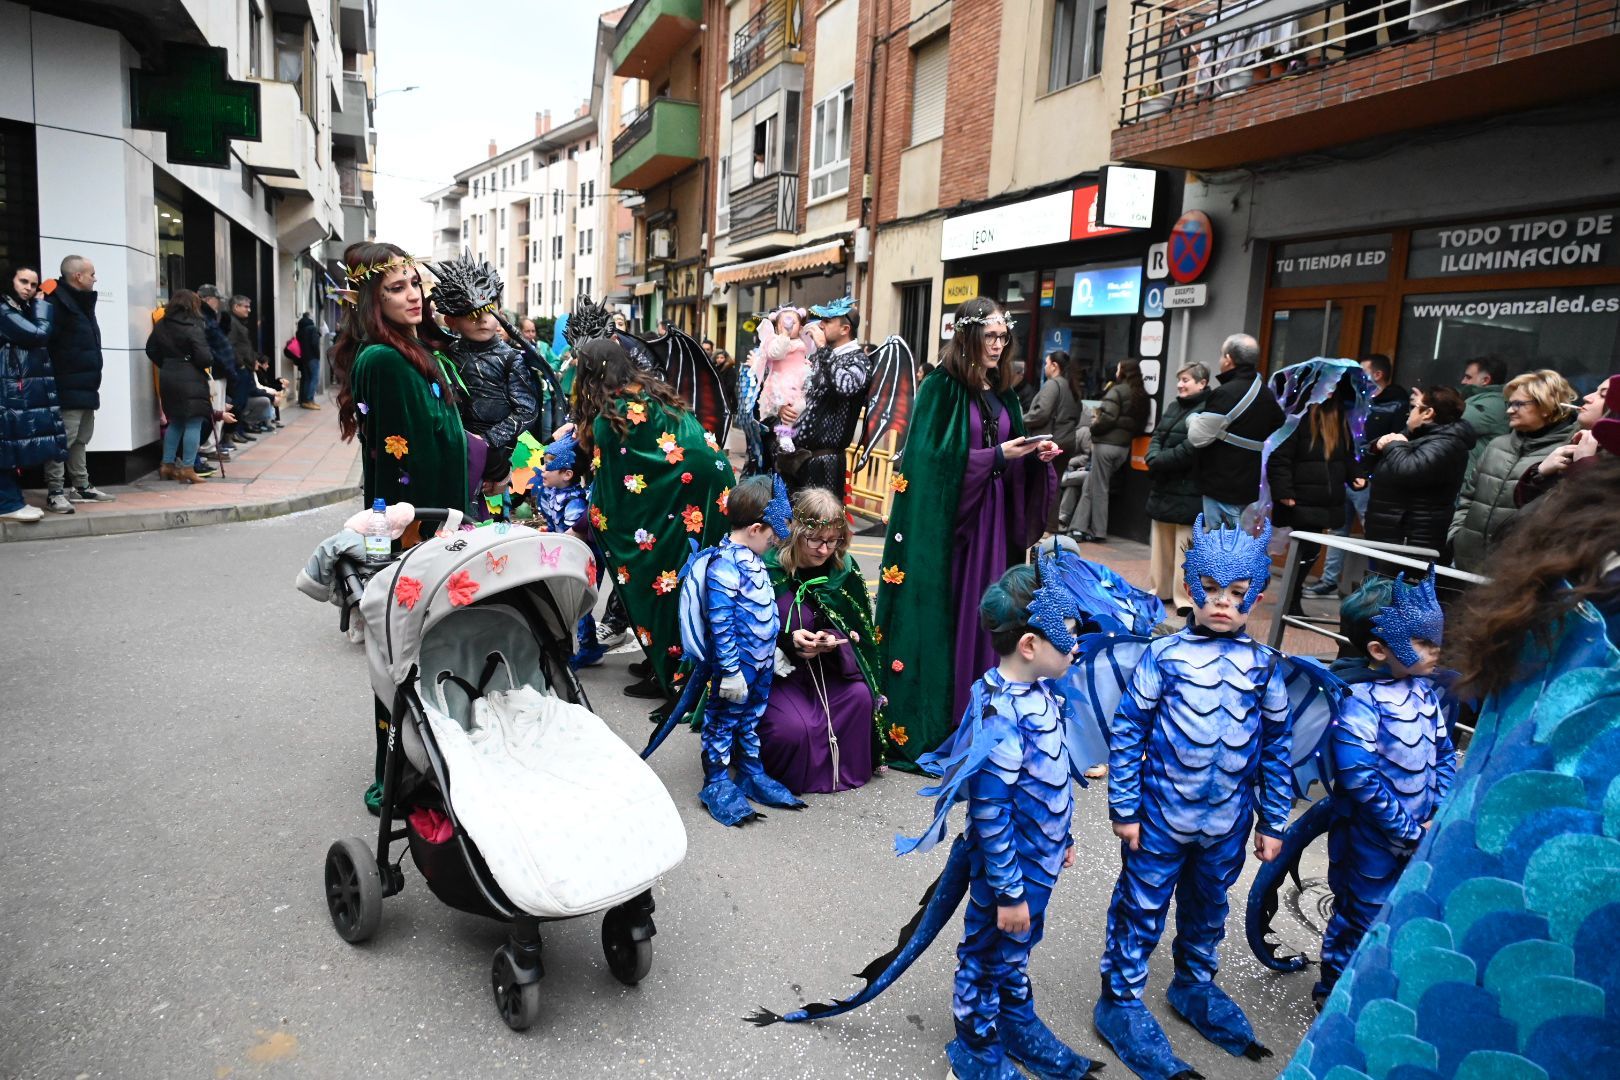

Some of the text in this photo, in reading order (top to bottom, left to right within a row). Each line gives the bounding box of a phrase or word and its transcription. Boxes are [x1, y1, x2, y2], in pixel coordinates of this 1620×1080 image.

[1438, 214, 1614, 249] TODO TIPO DE
[1276, 250, 1386, 273] TU TIENDA LED
[1441, 241, 1602, 272] ILUMINACIÓN
[1413, 295, 1620, 320] www.coyanzaled.es
